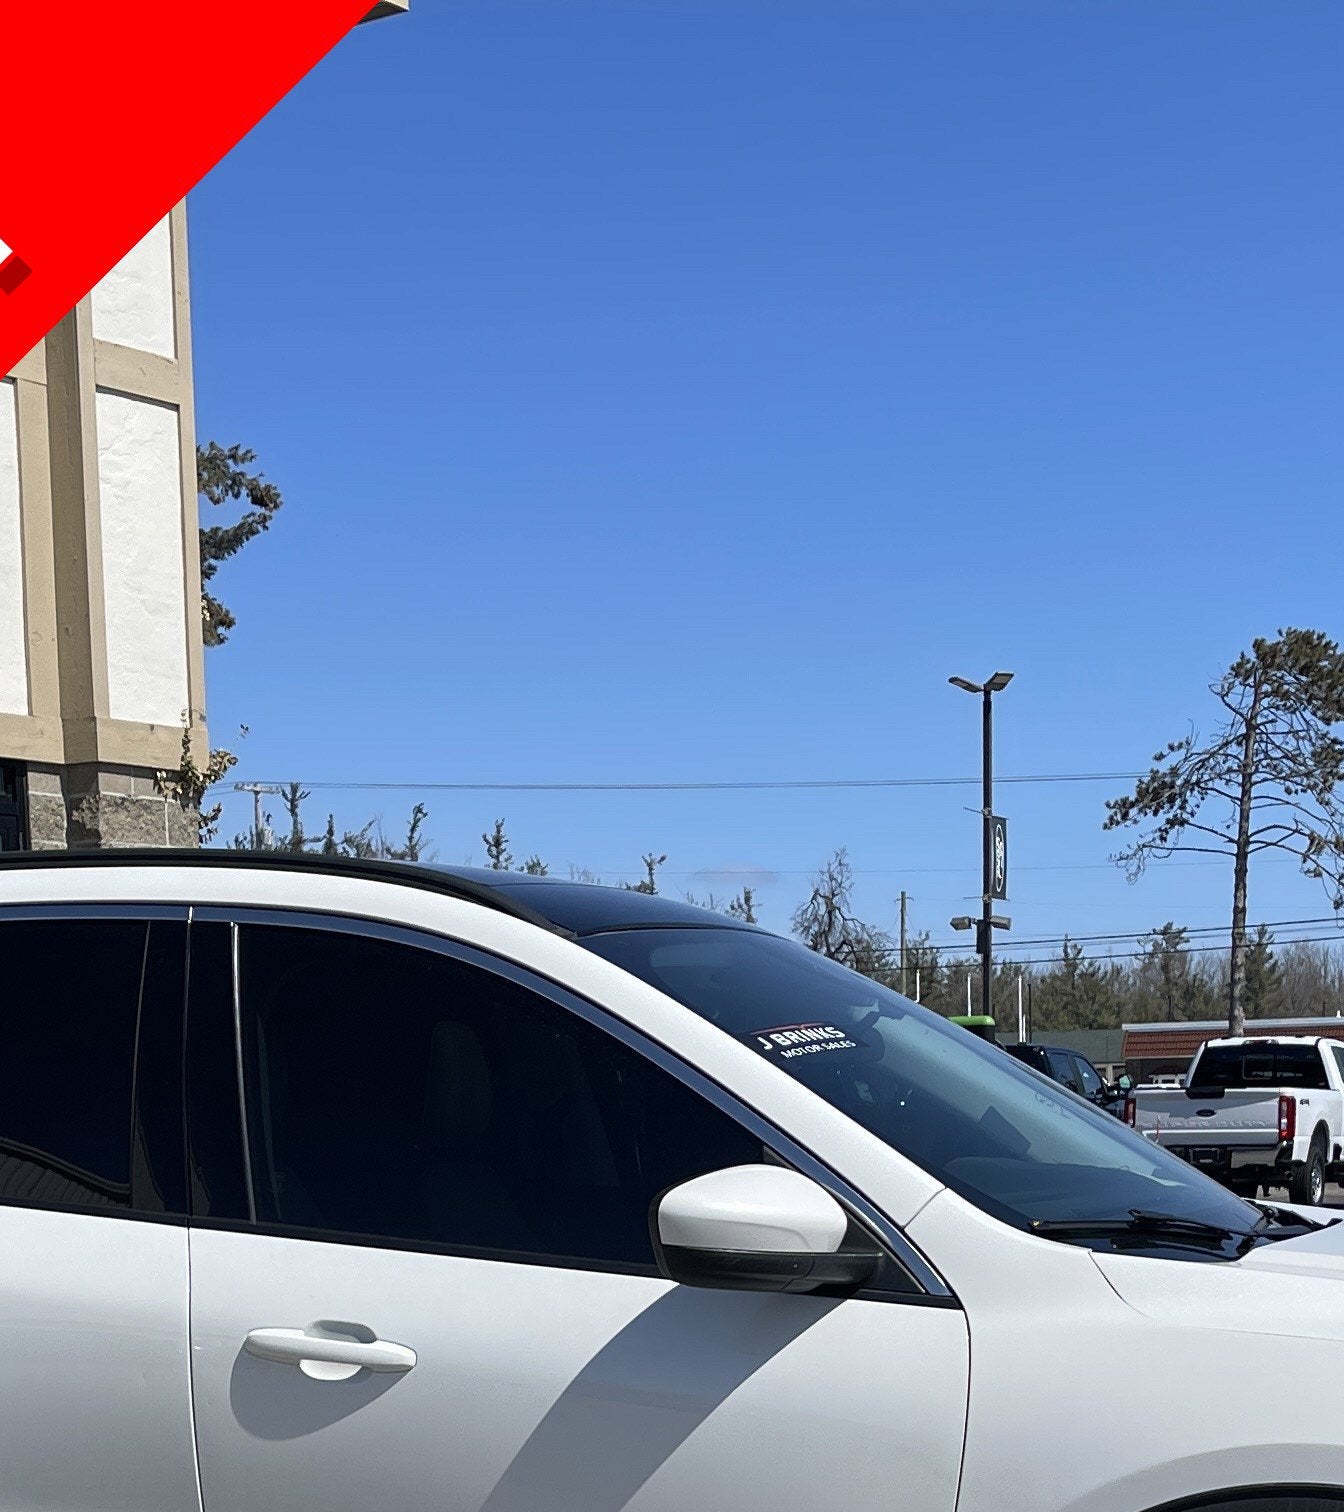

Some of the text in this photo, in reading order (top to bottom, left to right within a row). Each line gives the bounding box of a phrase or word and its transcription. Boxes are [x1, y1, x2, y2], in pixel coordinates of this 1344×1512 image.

[757, 1026, 846, 1050] J BRINKS
[780, 1040, 856, 1059] MOTOR SALES
